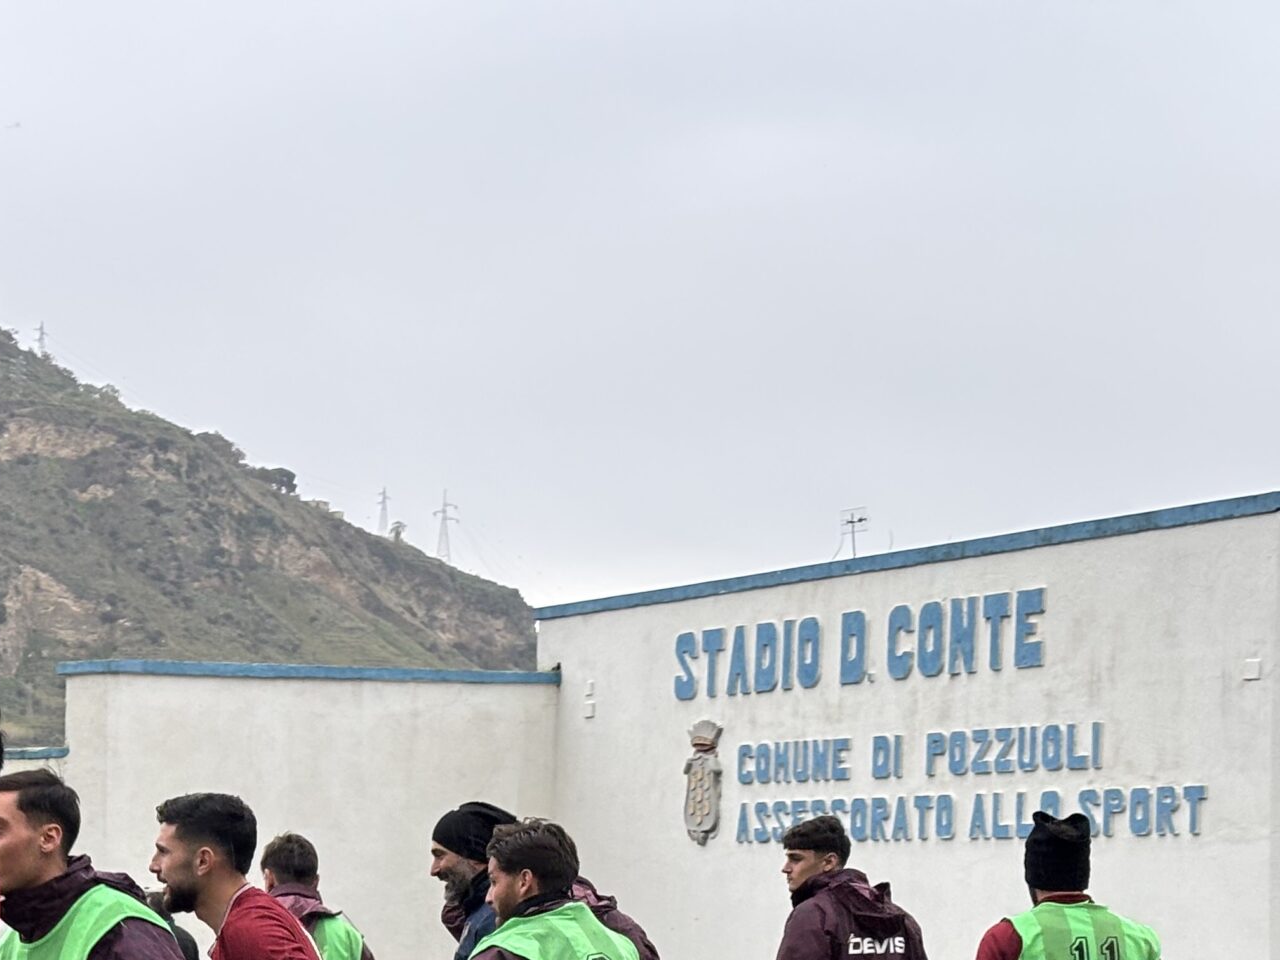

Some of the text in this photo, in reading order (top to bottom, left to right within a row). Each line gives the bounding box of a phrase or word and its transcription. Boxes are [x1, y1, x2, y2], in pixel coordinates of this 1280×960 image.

[673, 586, 1047, 701] STADIO D. CONTE
[736, 721, 1103, 785] COMUNE DI POZZUOLI
[1077, 784, 1207, 838] SPORT
[848, 935, 907, 956] DEVIS
